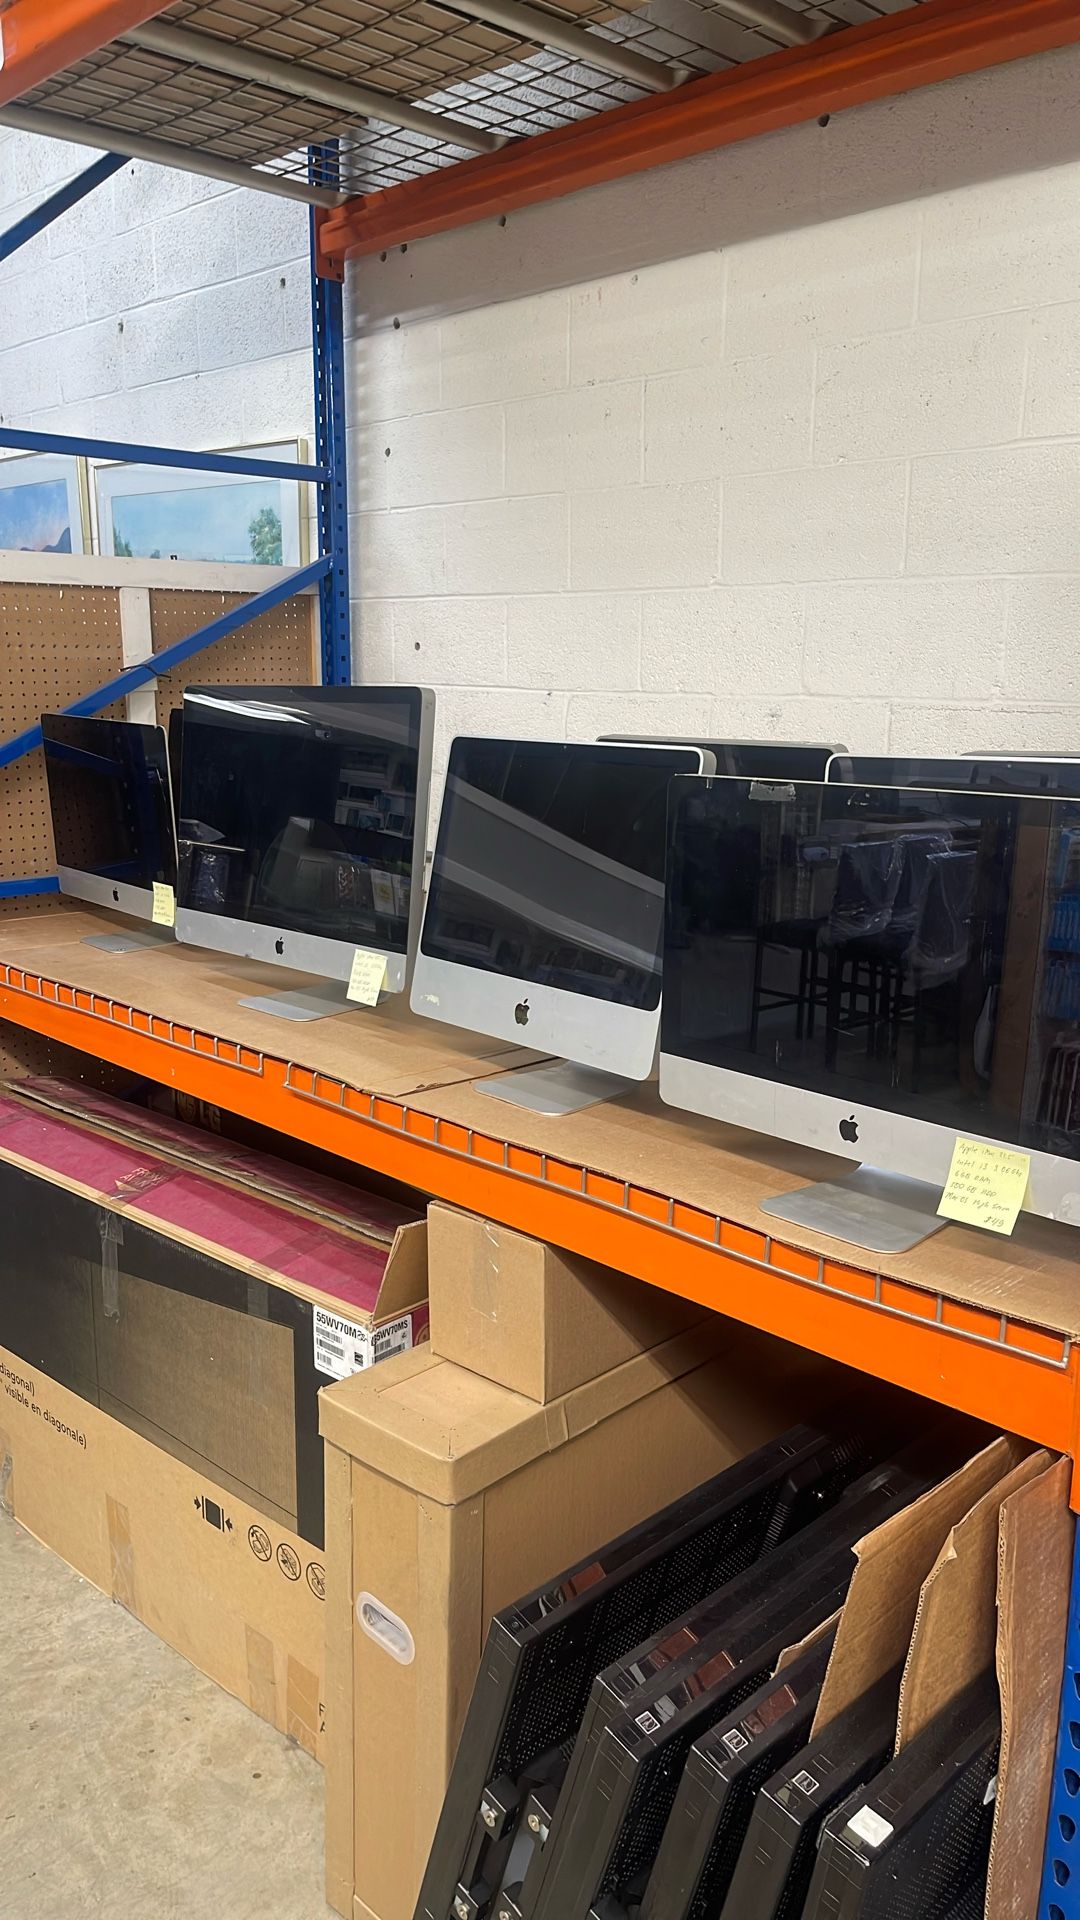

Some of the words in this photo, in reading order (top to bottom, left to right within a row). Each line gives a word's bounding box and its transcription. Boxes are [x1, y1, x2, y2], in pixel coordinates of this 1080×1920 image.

[959, 1143, 978, 1155] Apple
[0, 1363, 35, 1397] diagonal)
[5, 1384, 29, 1408] visible
[31, 1403, 41, 1417] en
[43, 1409, 86, 1450] diagonale)
